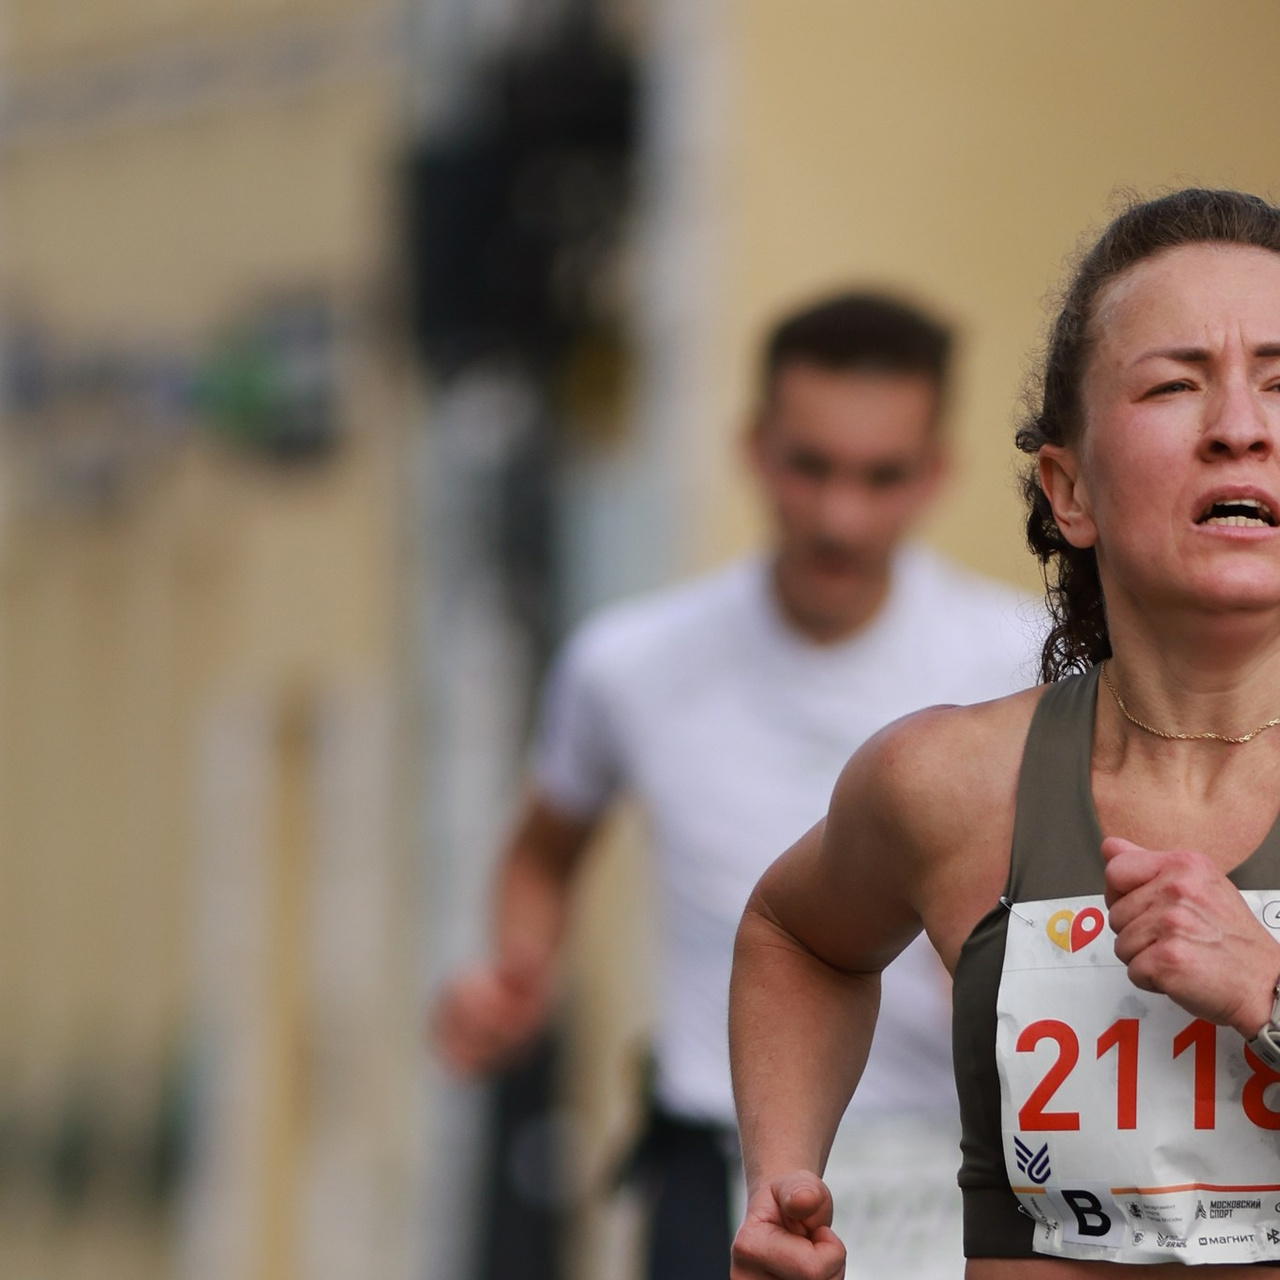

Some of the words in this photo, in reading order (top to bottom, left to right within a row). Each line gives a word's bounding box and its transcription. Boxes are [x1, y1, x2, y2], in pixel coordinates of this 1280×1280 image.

[1210, 1199, 1261, 1210] МОСКОВСКИЙ
[1061, 1189, 1112, 1237] B
[1210, 1209, 1233, 1219] СПОРТ
